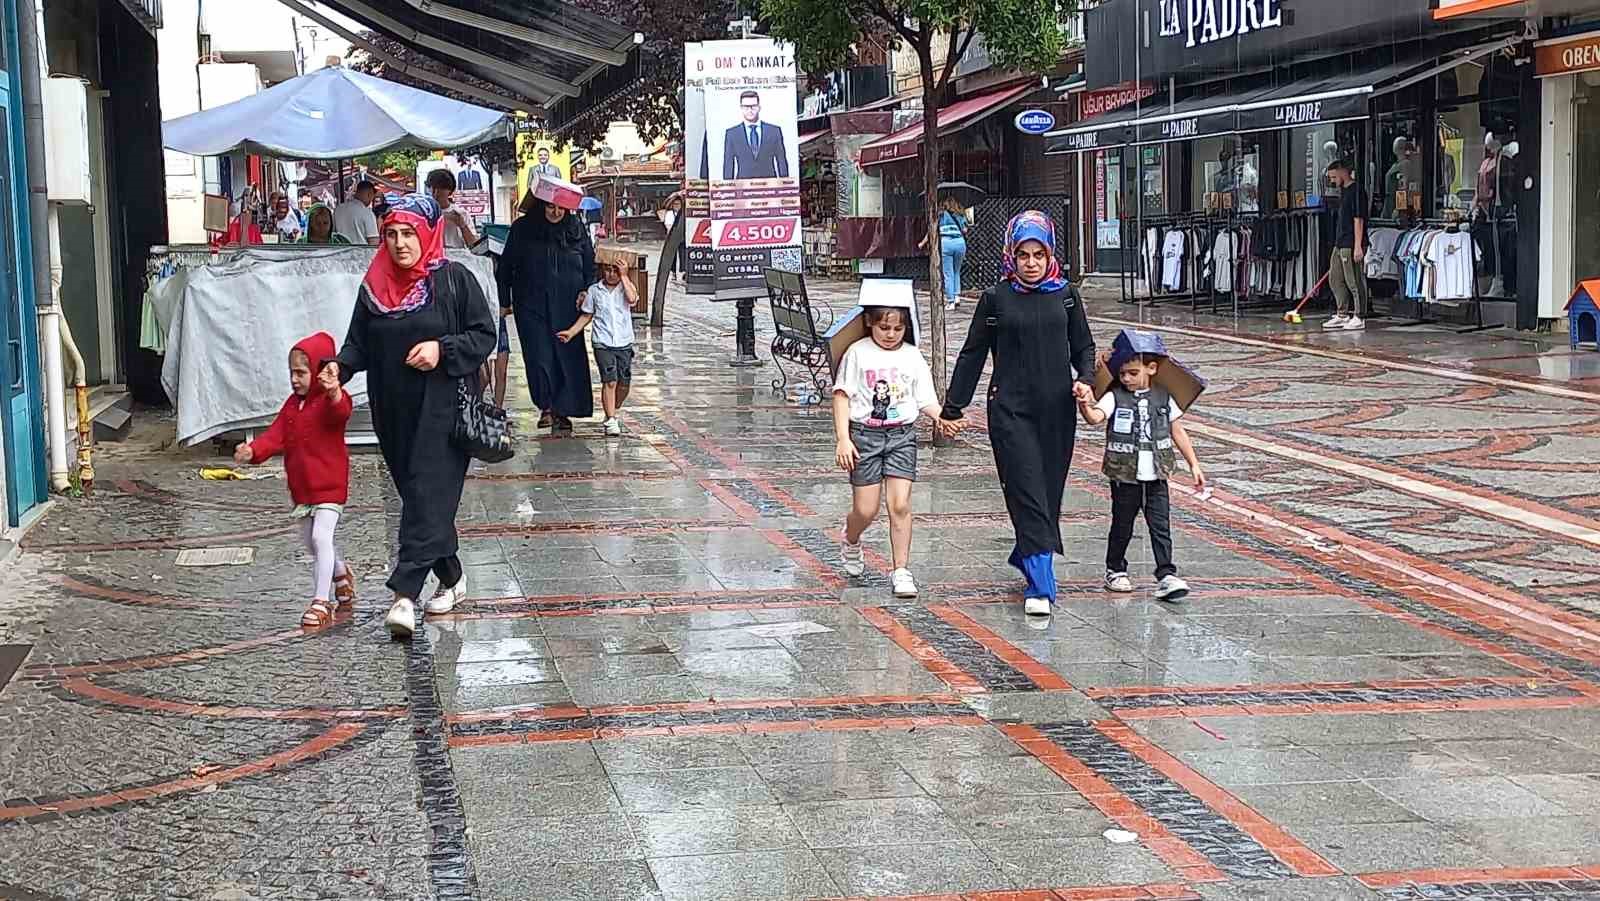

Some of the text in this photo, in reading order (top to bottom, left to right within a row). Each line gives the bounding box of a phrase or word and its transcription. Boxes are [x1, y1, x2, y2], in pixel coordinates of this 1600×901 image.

[1160, 0, 1281, 48] LA PADRE
[1275, 101, 1321, 124] LA PADRE
[1162, 119, 1198, 137] LA PADRE
[1068, 132, 1098, 149] LA PADRE
[689, 251, 703, 259] 60
[719, 254, 732, 262] 60
